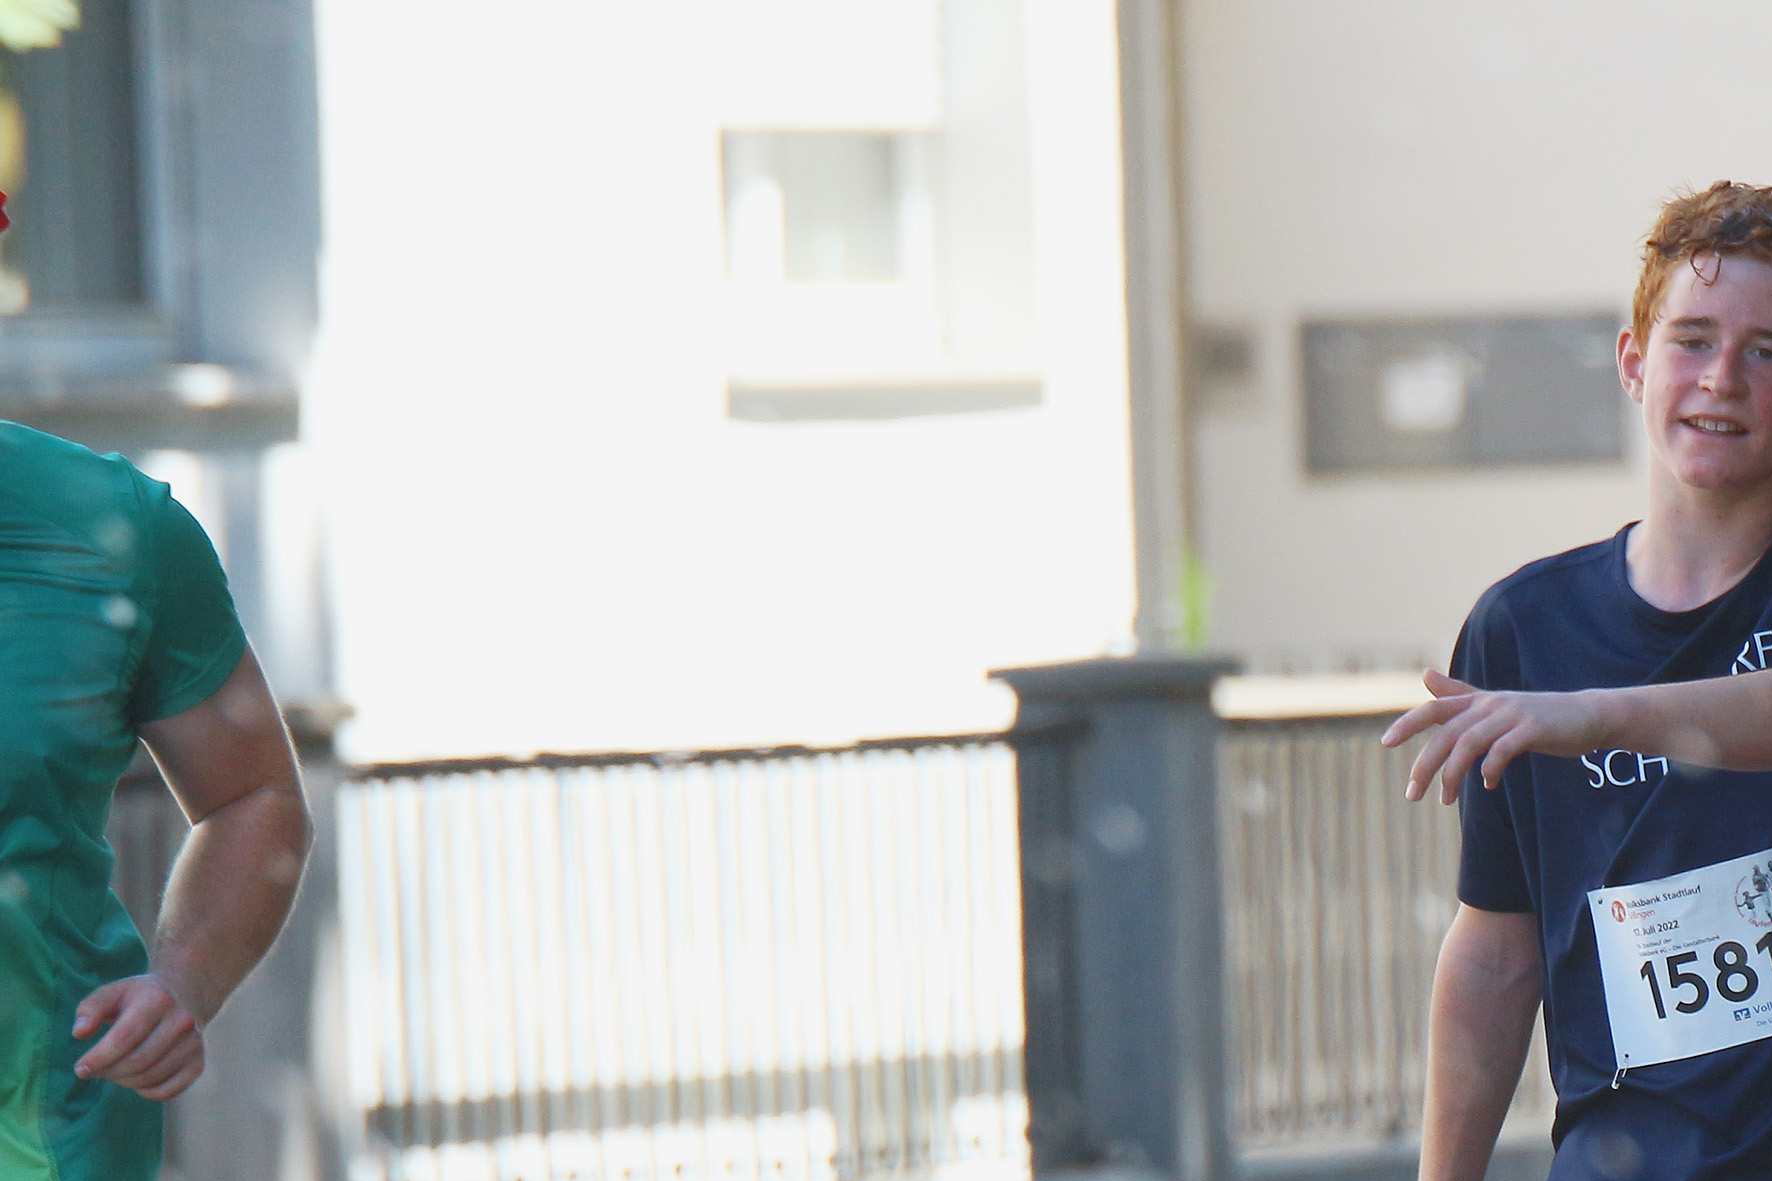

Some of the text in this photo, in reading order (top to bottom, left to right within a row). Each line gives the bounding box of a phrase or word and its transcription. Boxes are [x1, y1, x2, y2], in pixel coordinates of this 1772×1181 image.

[1662, 885, 1701, 902] Stadtlauf
[1643, 925, 1656, 936] Juli
[1658, 920, 1680, 933] 2022
